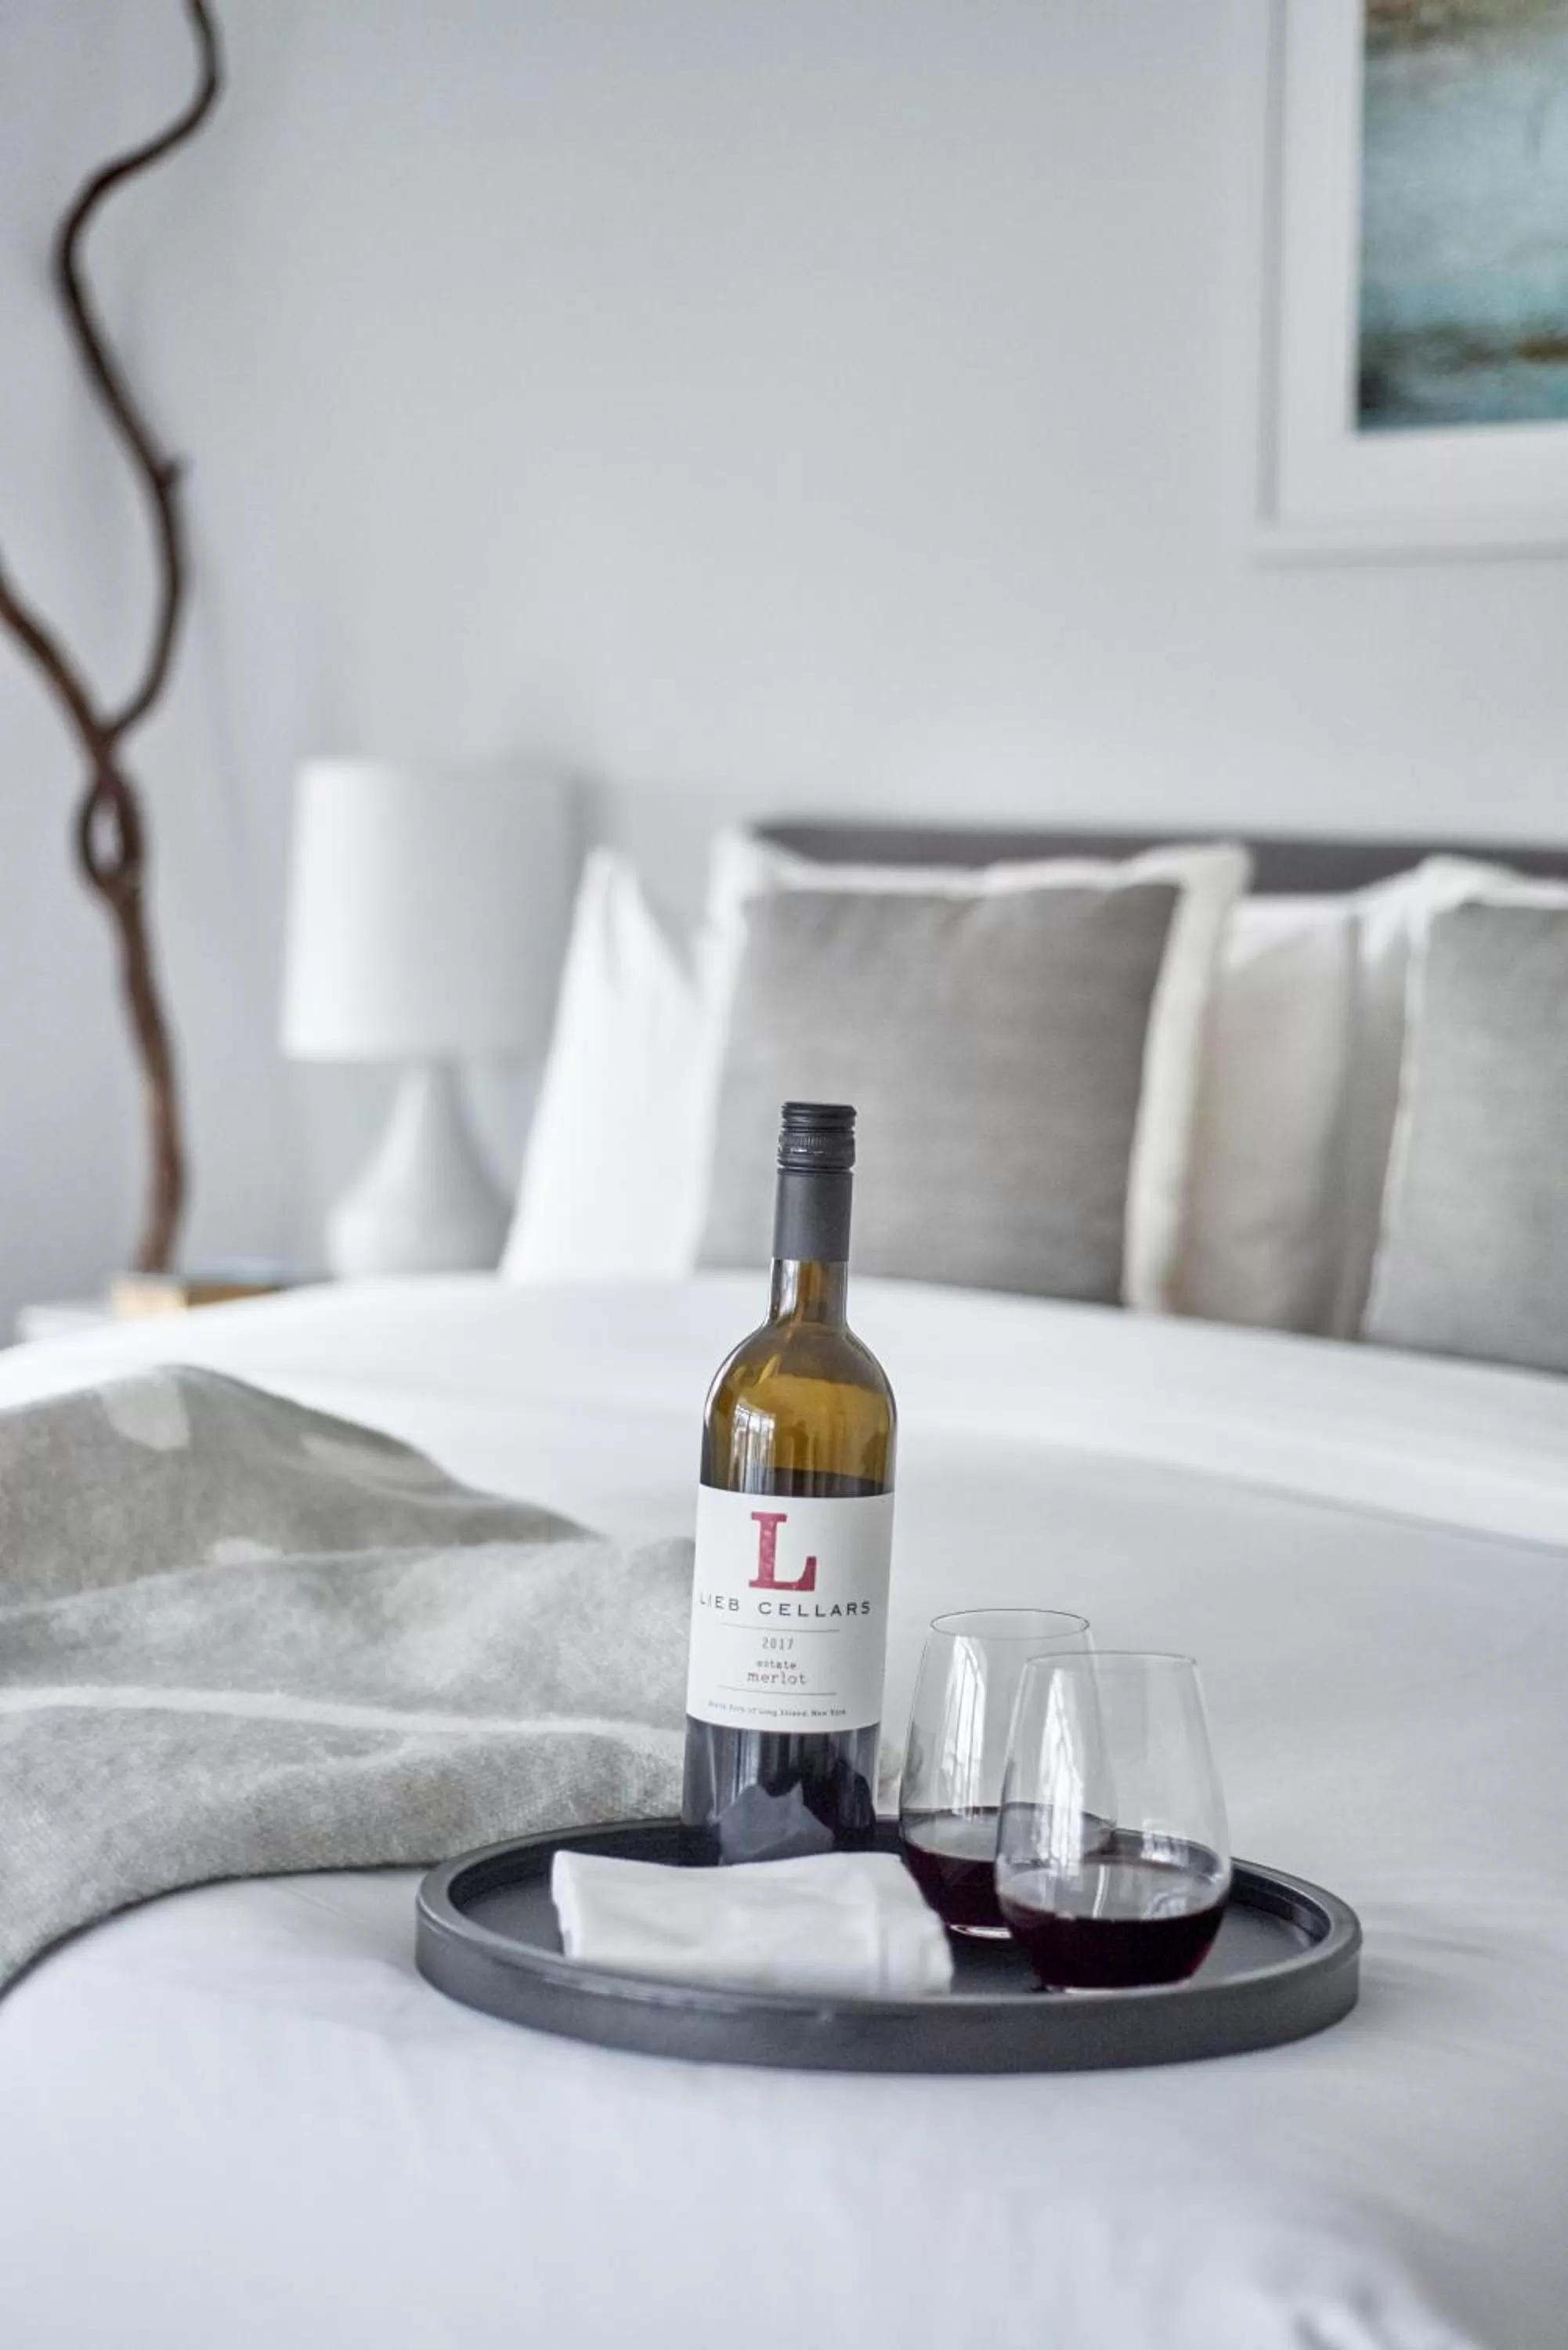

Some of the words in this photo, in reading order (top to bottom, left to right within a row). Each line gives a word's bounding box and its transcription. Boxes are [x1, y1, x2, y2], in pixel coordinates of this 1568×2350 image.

[750, 1511, 817, 1592] L
[699, 1591, 740, 1611] LIEB
[757, 1600, 872, 1618] CELLARS
[761, 1636, 794, 1650] 2017
[756, 1659, 797, 1670] estate
[746, 1671, 807, 1686] merlot
